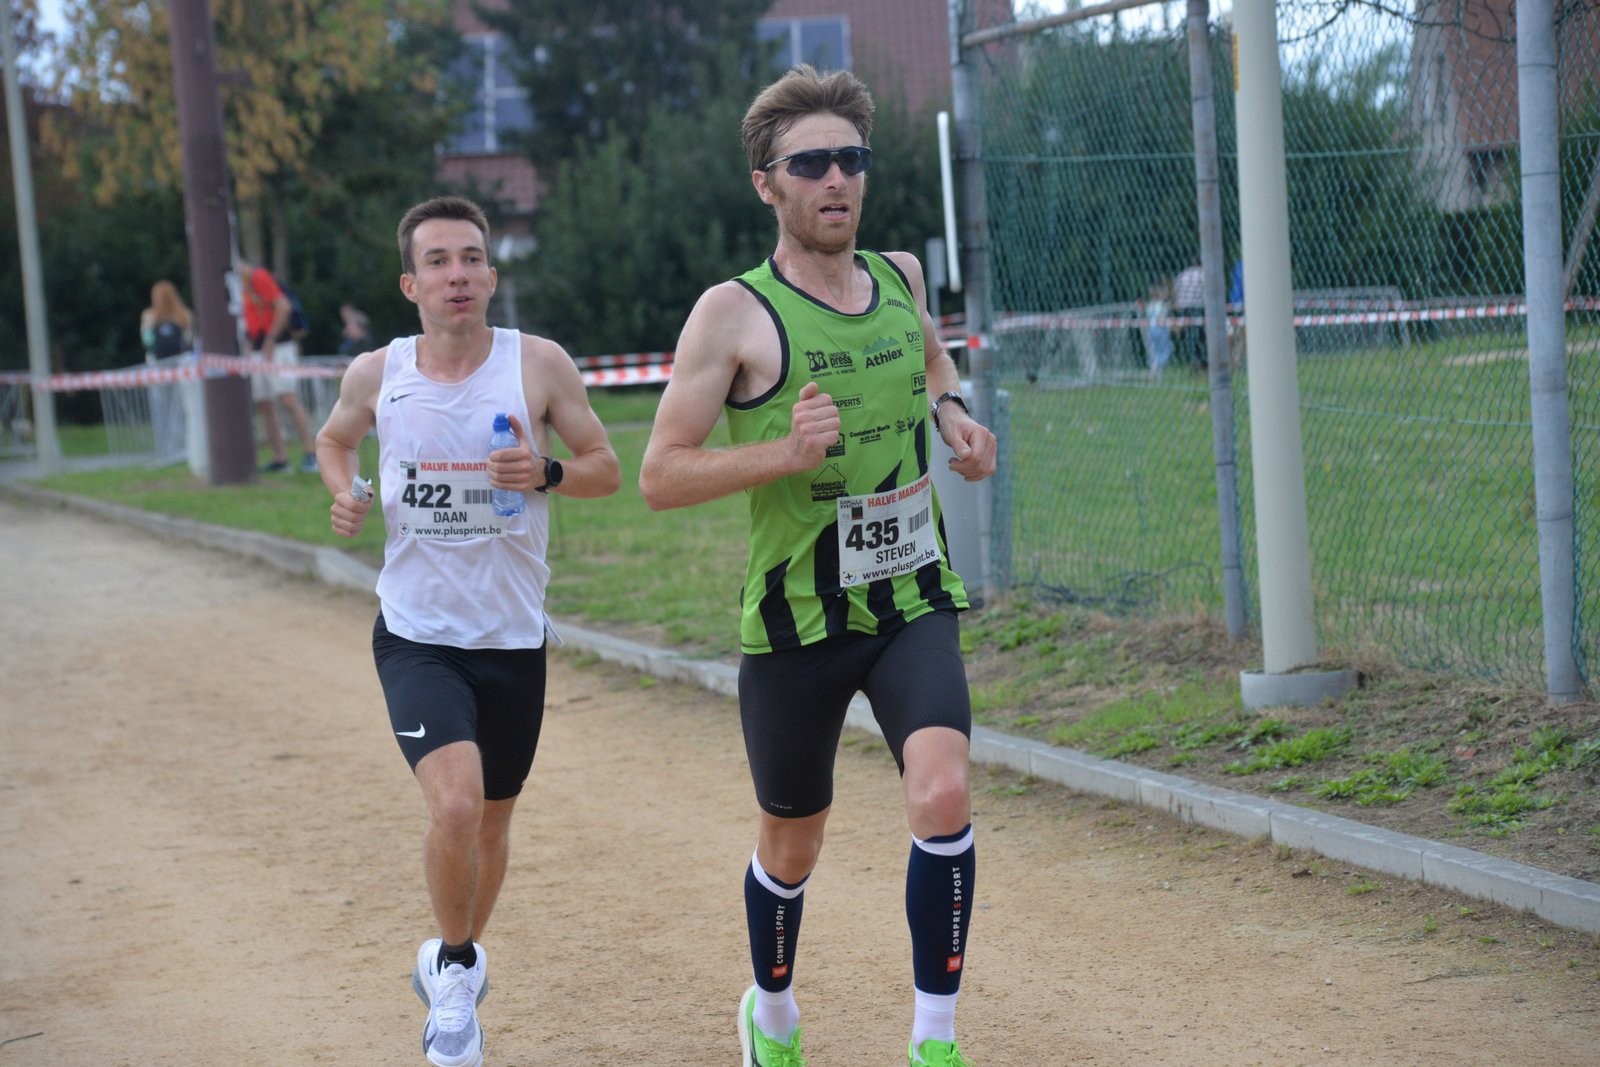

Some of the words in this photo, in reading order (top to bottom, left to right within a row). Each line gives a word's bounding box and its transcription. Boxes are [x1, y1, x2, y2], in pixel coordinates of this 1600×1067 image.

[830, 355, 853, 368] press
[865, 348, 904, 369] Athlex
[420, 462, 449, 471] HALVE
[402, 483, 452, 508] 422
[867, 493, 897, 508] HALVE
[433, 511, 467, 523] DAAN
[415, 525, 502, 537] www.plusprint.be
[845, 516, 899, 551] 435
[875, 540, 916, 564] STEVEN
[862, 549, 936, 580] www.plusprint.be
[952, 866, 962, 952] COMPRESSPORT
[776, 904, 786, 964] COMPRESSPORT
